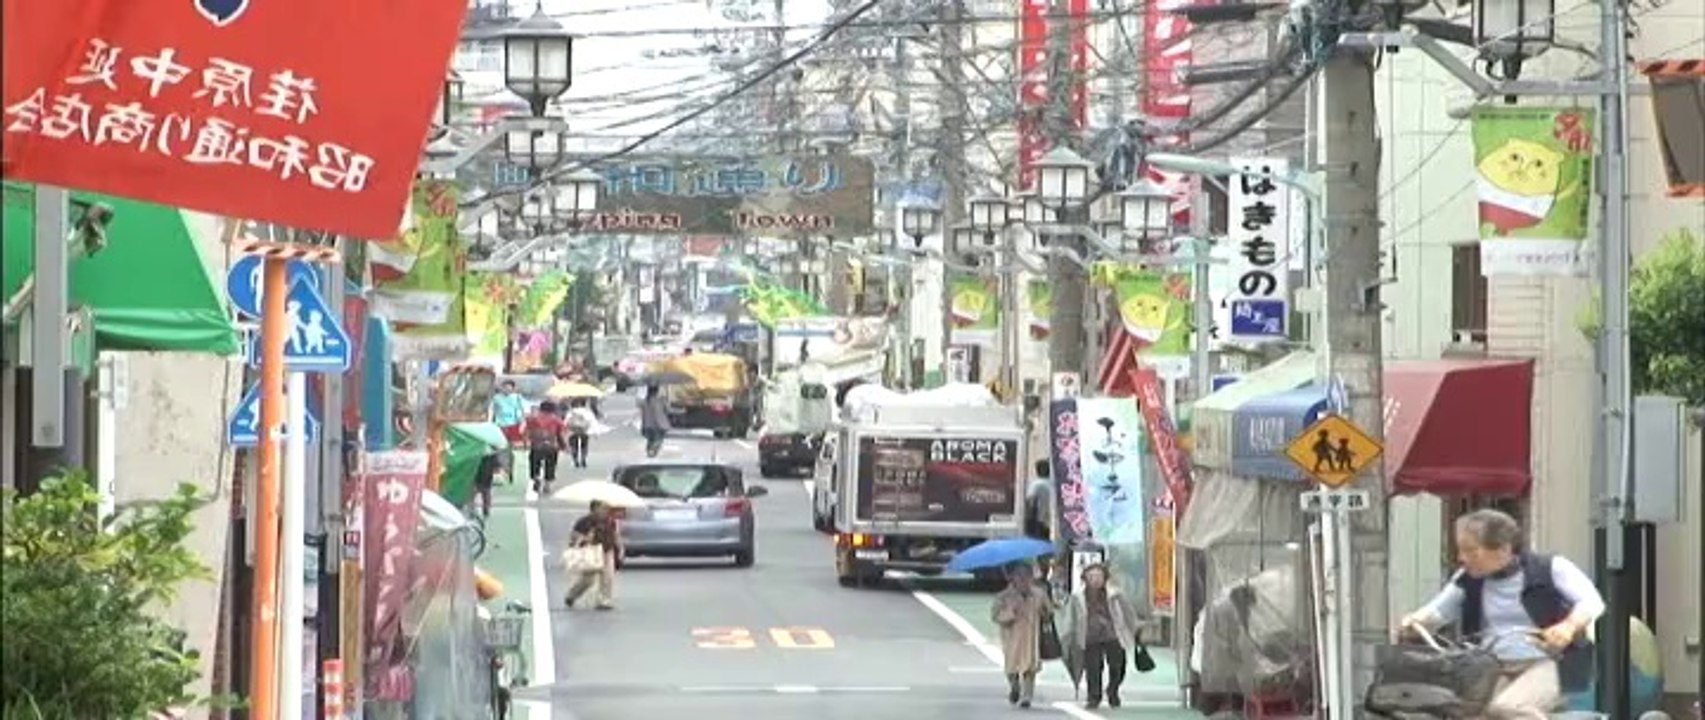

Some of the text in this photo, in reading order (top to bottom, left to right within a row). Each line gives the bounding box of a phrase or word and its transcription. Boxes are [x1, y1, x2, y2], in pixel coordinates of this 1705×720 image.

[1238, 165, 1278, 296] はきもの
[930, 439, 1007, 451] AROMA
[930, 452, 1007, 463] BLACK
[691, 627, 835, 647] 30
